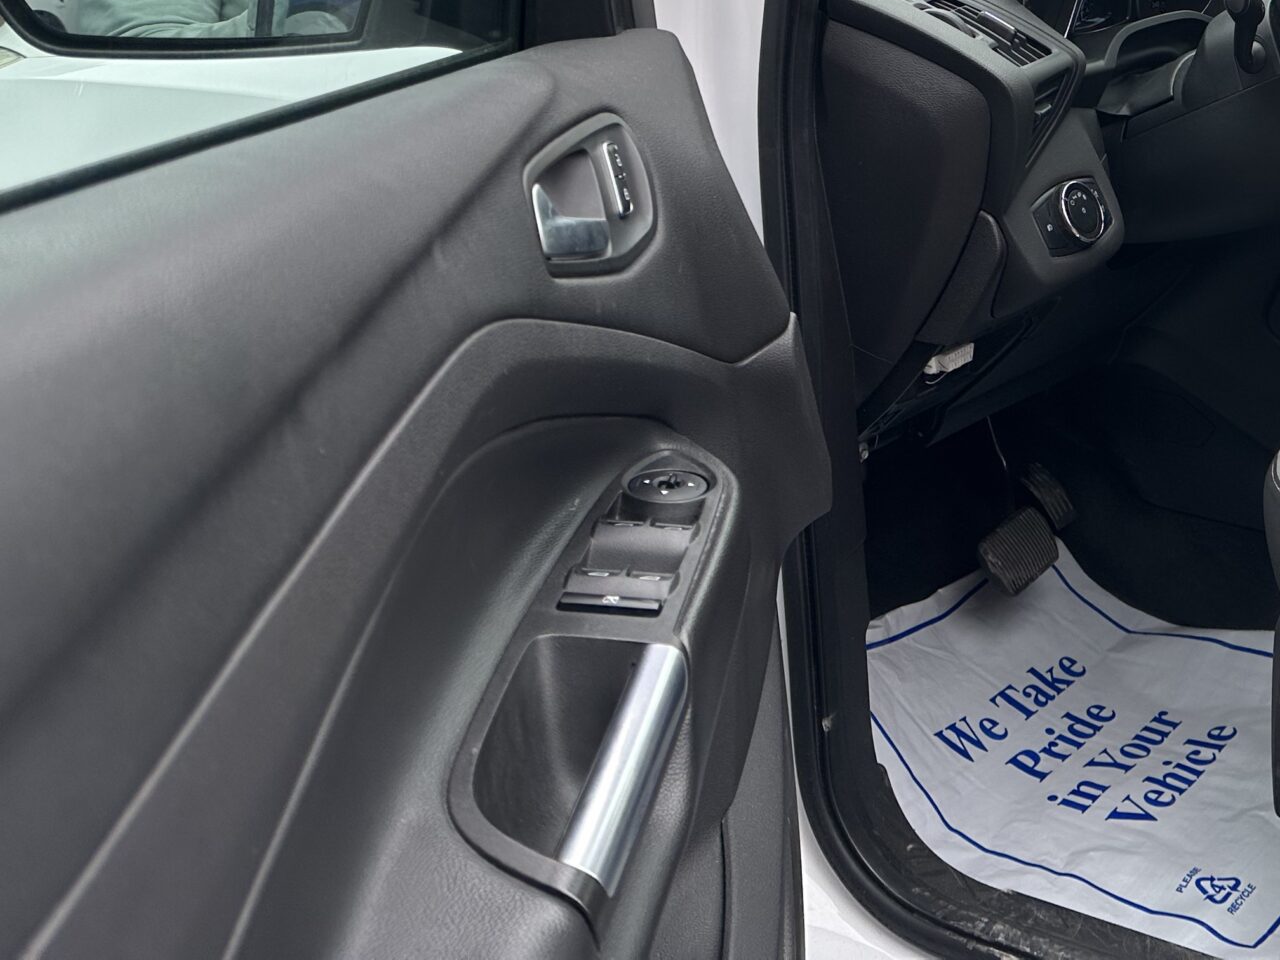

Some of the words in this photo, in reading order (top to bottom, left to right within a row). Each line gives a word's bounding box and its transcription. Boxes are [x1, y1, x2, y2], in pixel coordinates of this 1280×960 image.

[934, 712, 1009, 763] We
[989, 653, 1087, 721] Take
[1005, 701, 1116, 782] Pride
[1046, 779, 1112, 814] in
[1085, 708, 1184, 780] Your
[1105, 722, 1238, 823] Vehicle
[1175, 866, 1202, 894] PLEASE
[1226, 883, 1257, 916] RECYCLE
